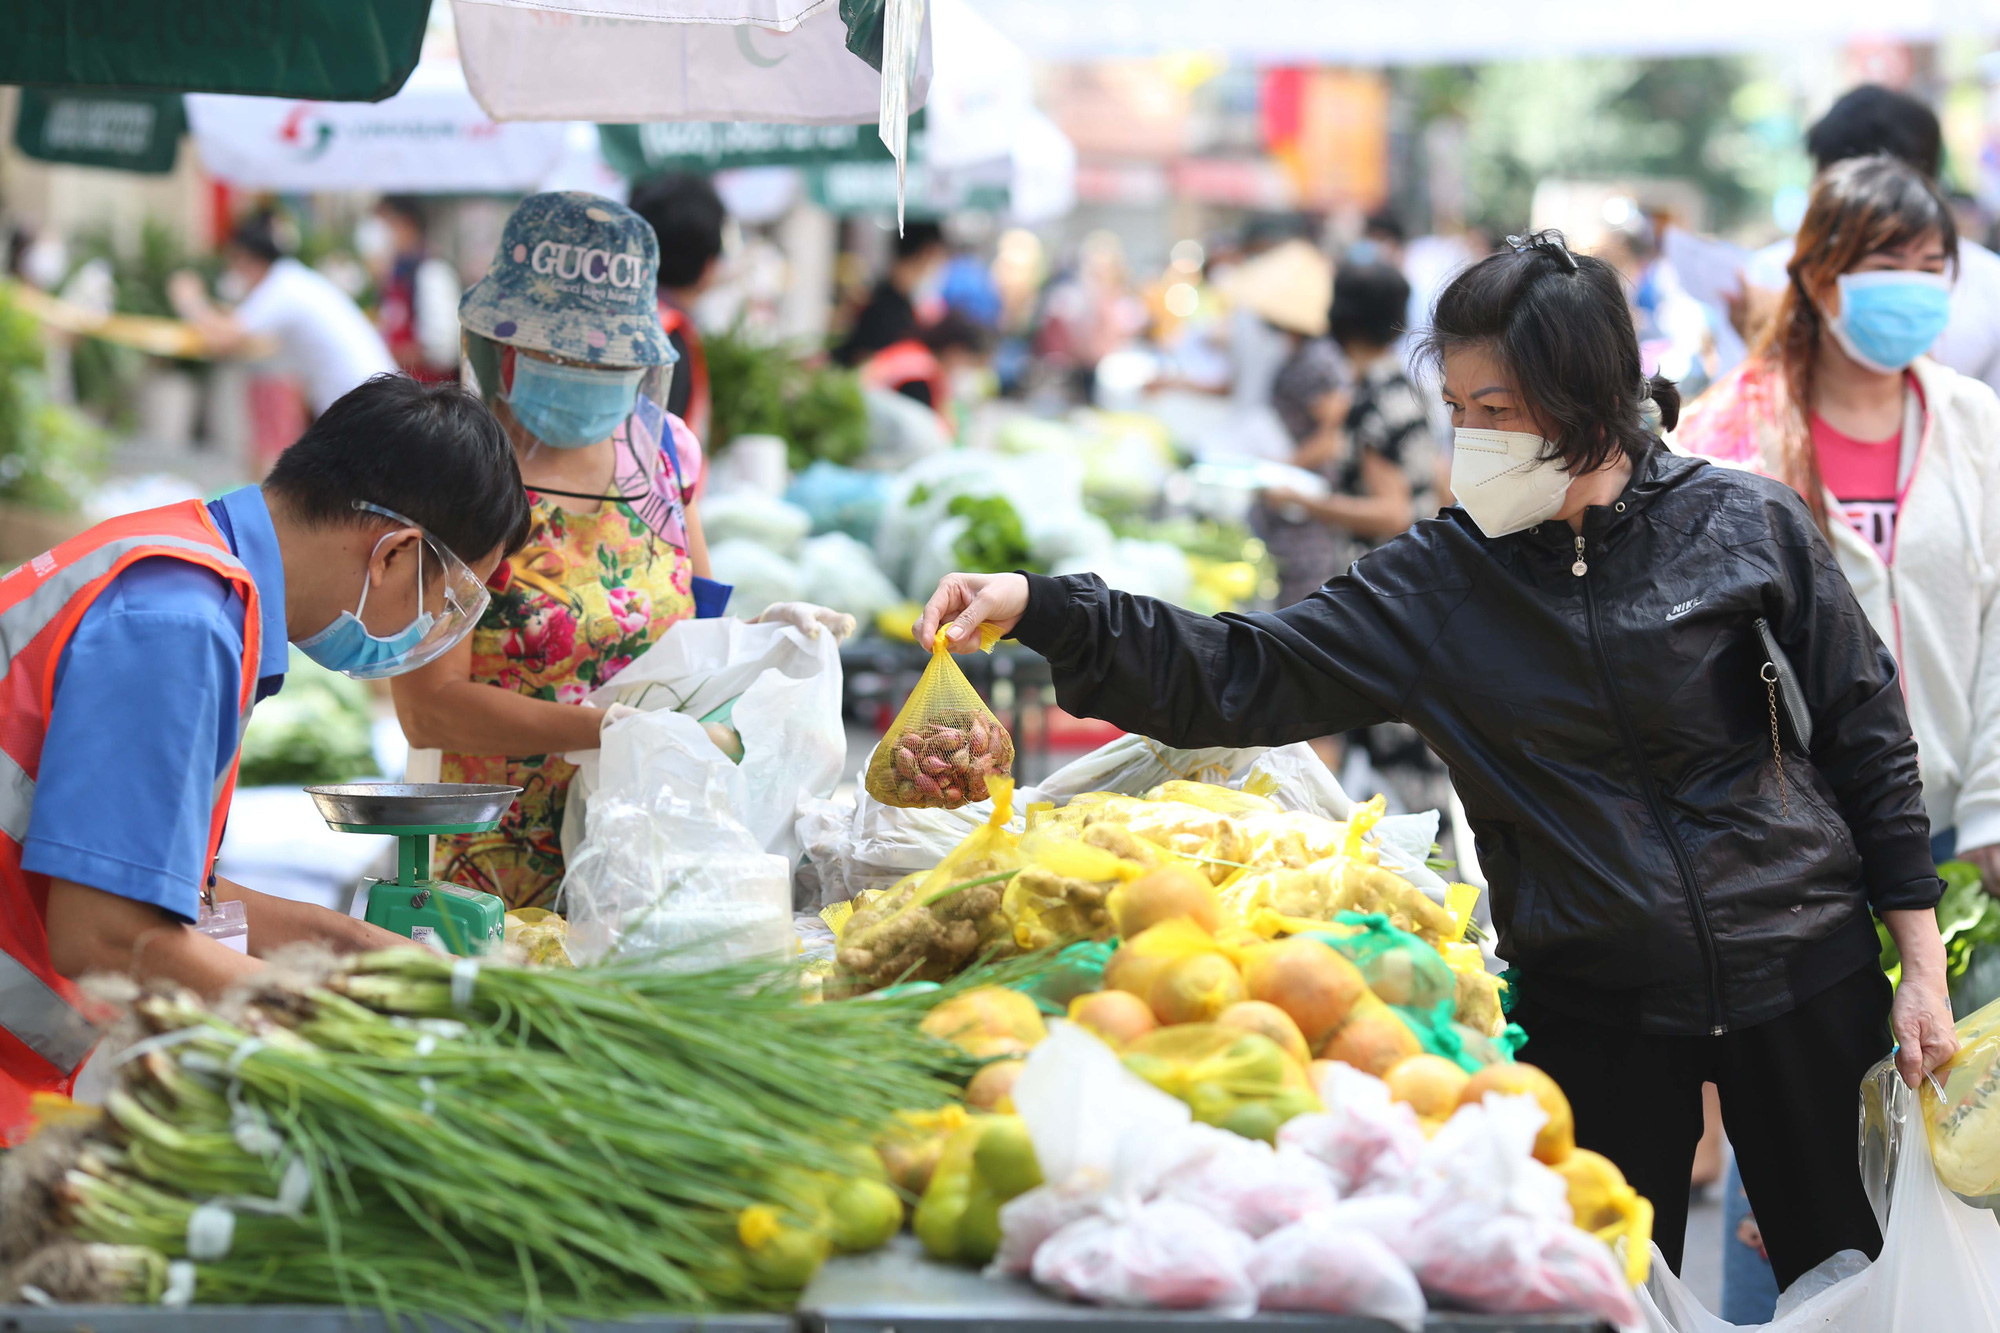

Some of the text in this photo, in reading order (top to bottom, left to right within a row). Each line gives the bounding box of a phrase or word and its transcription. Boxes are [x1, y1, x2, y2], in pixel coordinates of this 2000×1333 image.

[531, 240, 643, 289] GUCCI
[551, 279, 581, 295] Gucci
[582, 285, 606, 303] logo
[1672, 596, 1700, 614] NIKE
